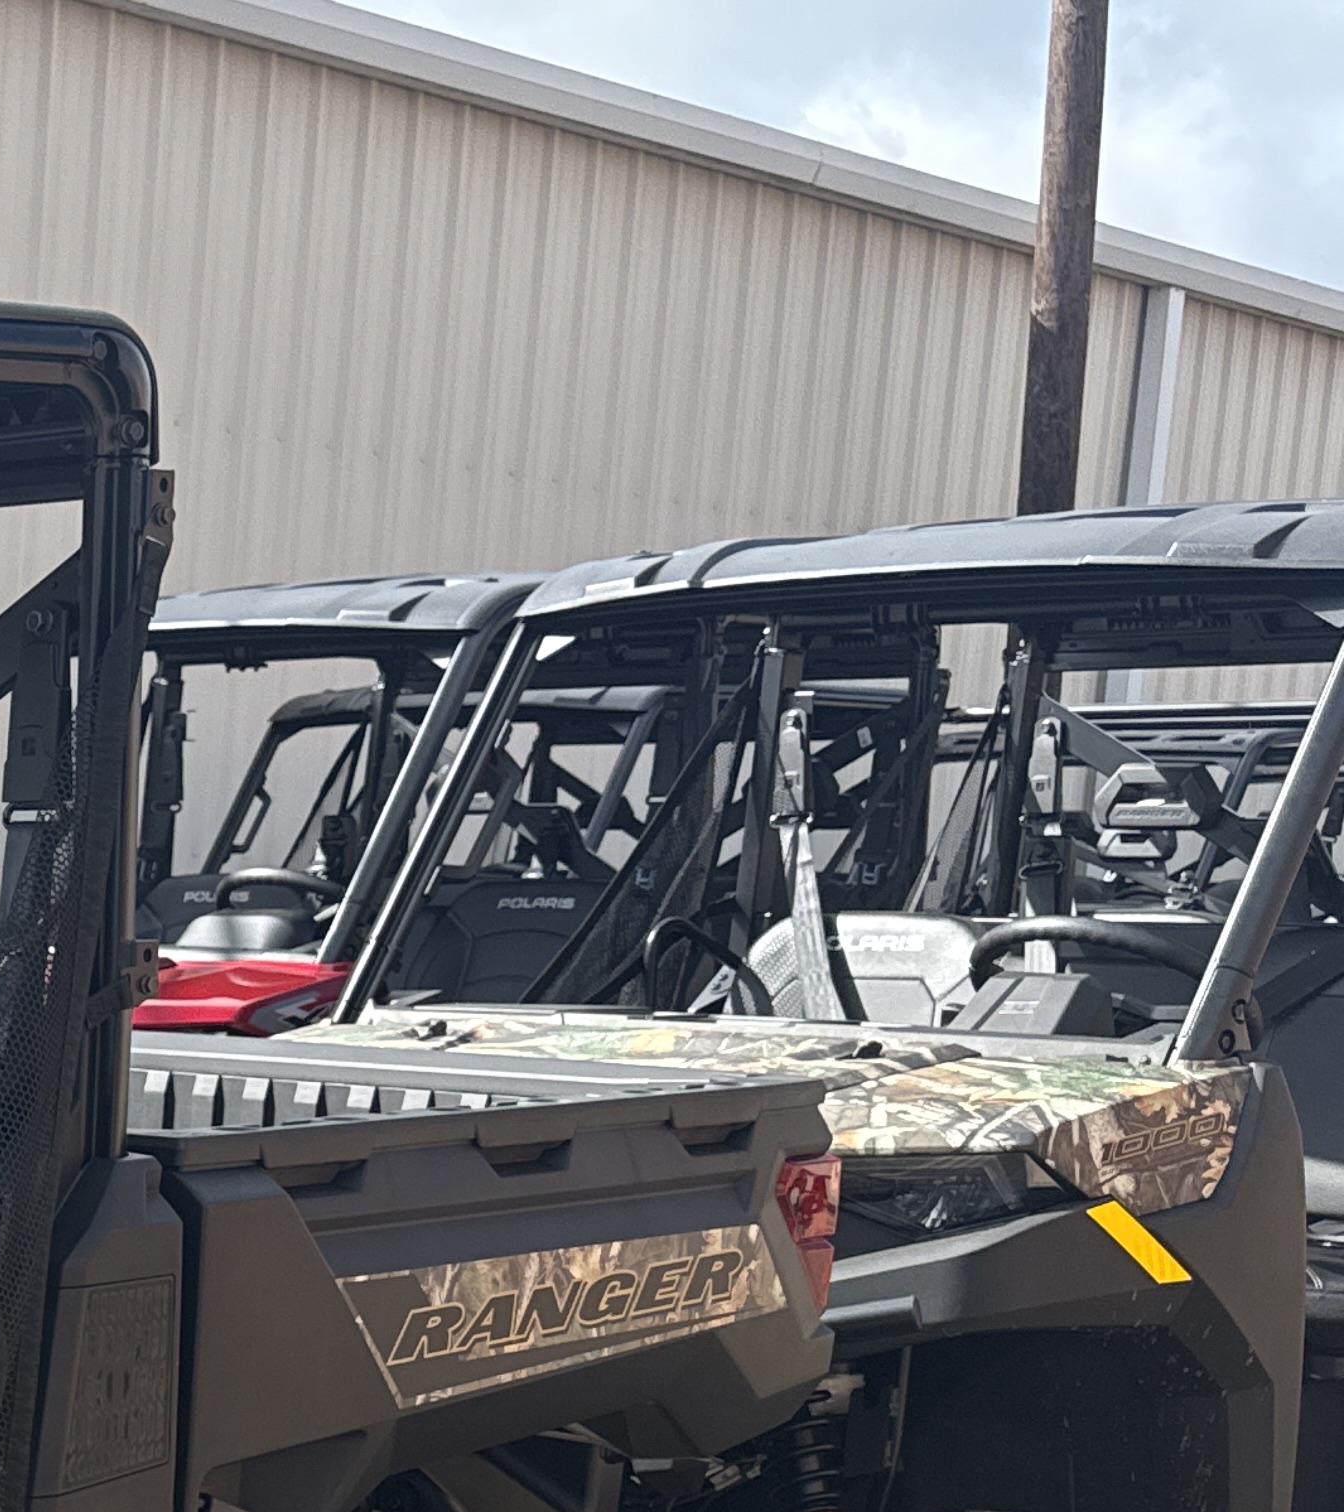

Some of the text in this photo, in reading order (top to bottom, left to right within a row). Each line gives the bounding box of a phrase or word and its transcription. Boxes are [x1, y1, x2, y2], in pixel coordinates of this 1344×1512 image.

[497, 896, 576, 911] POLARIS
[826, 934, 926, 952] OLARIS
[1100, 1112, 1225, 1166] 1000
[386, 1249, 745, 1366] RANGER
